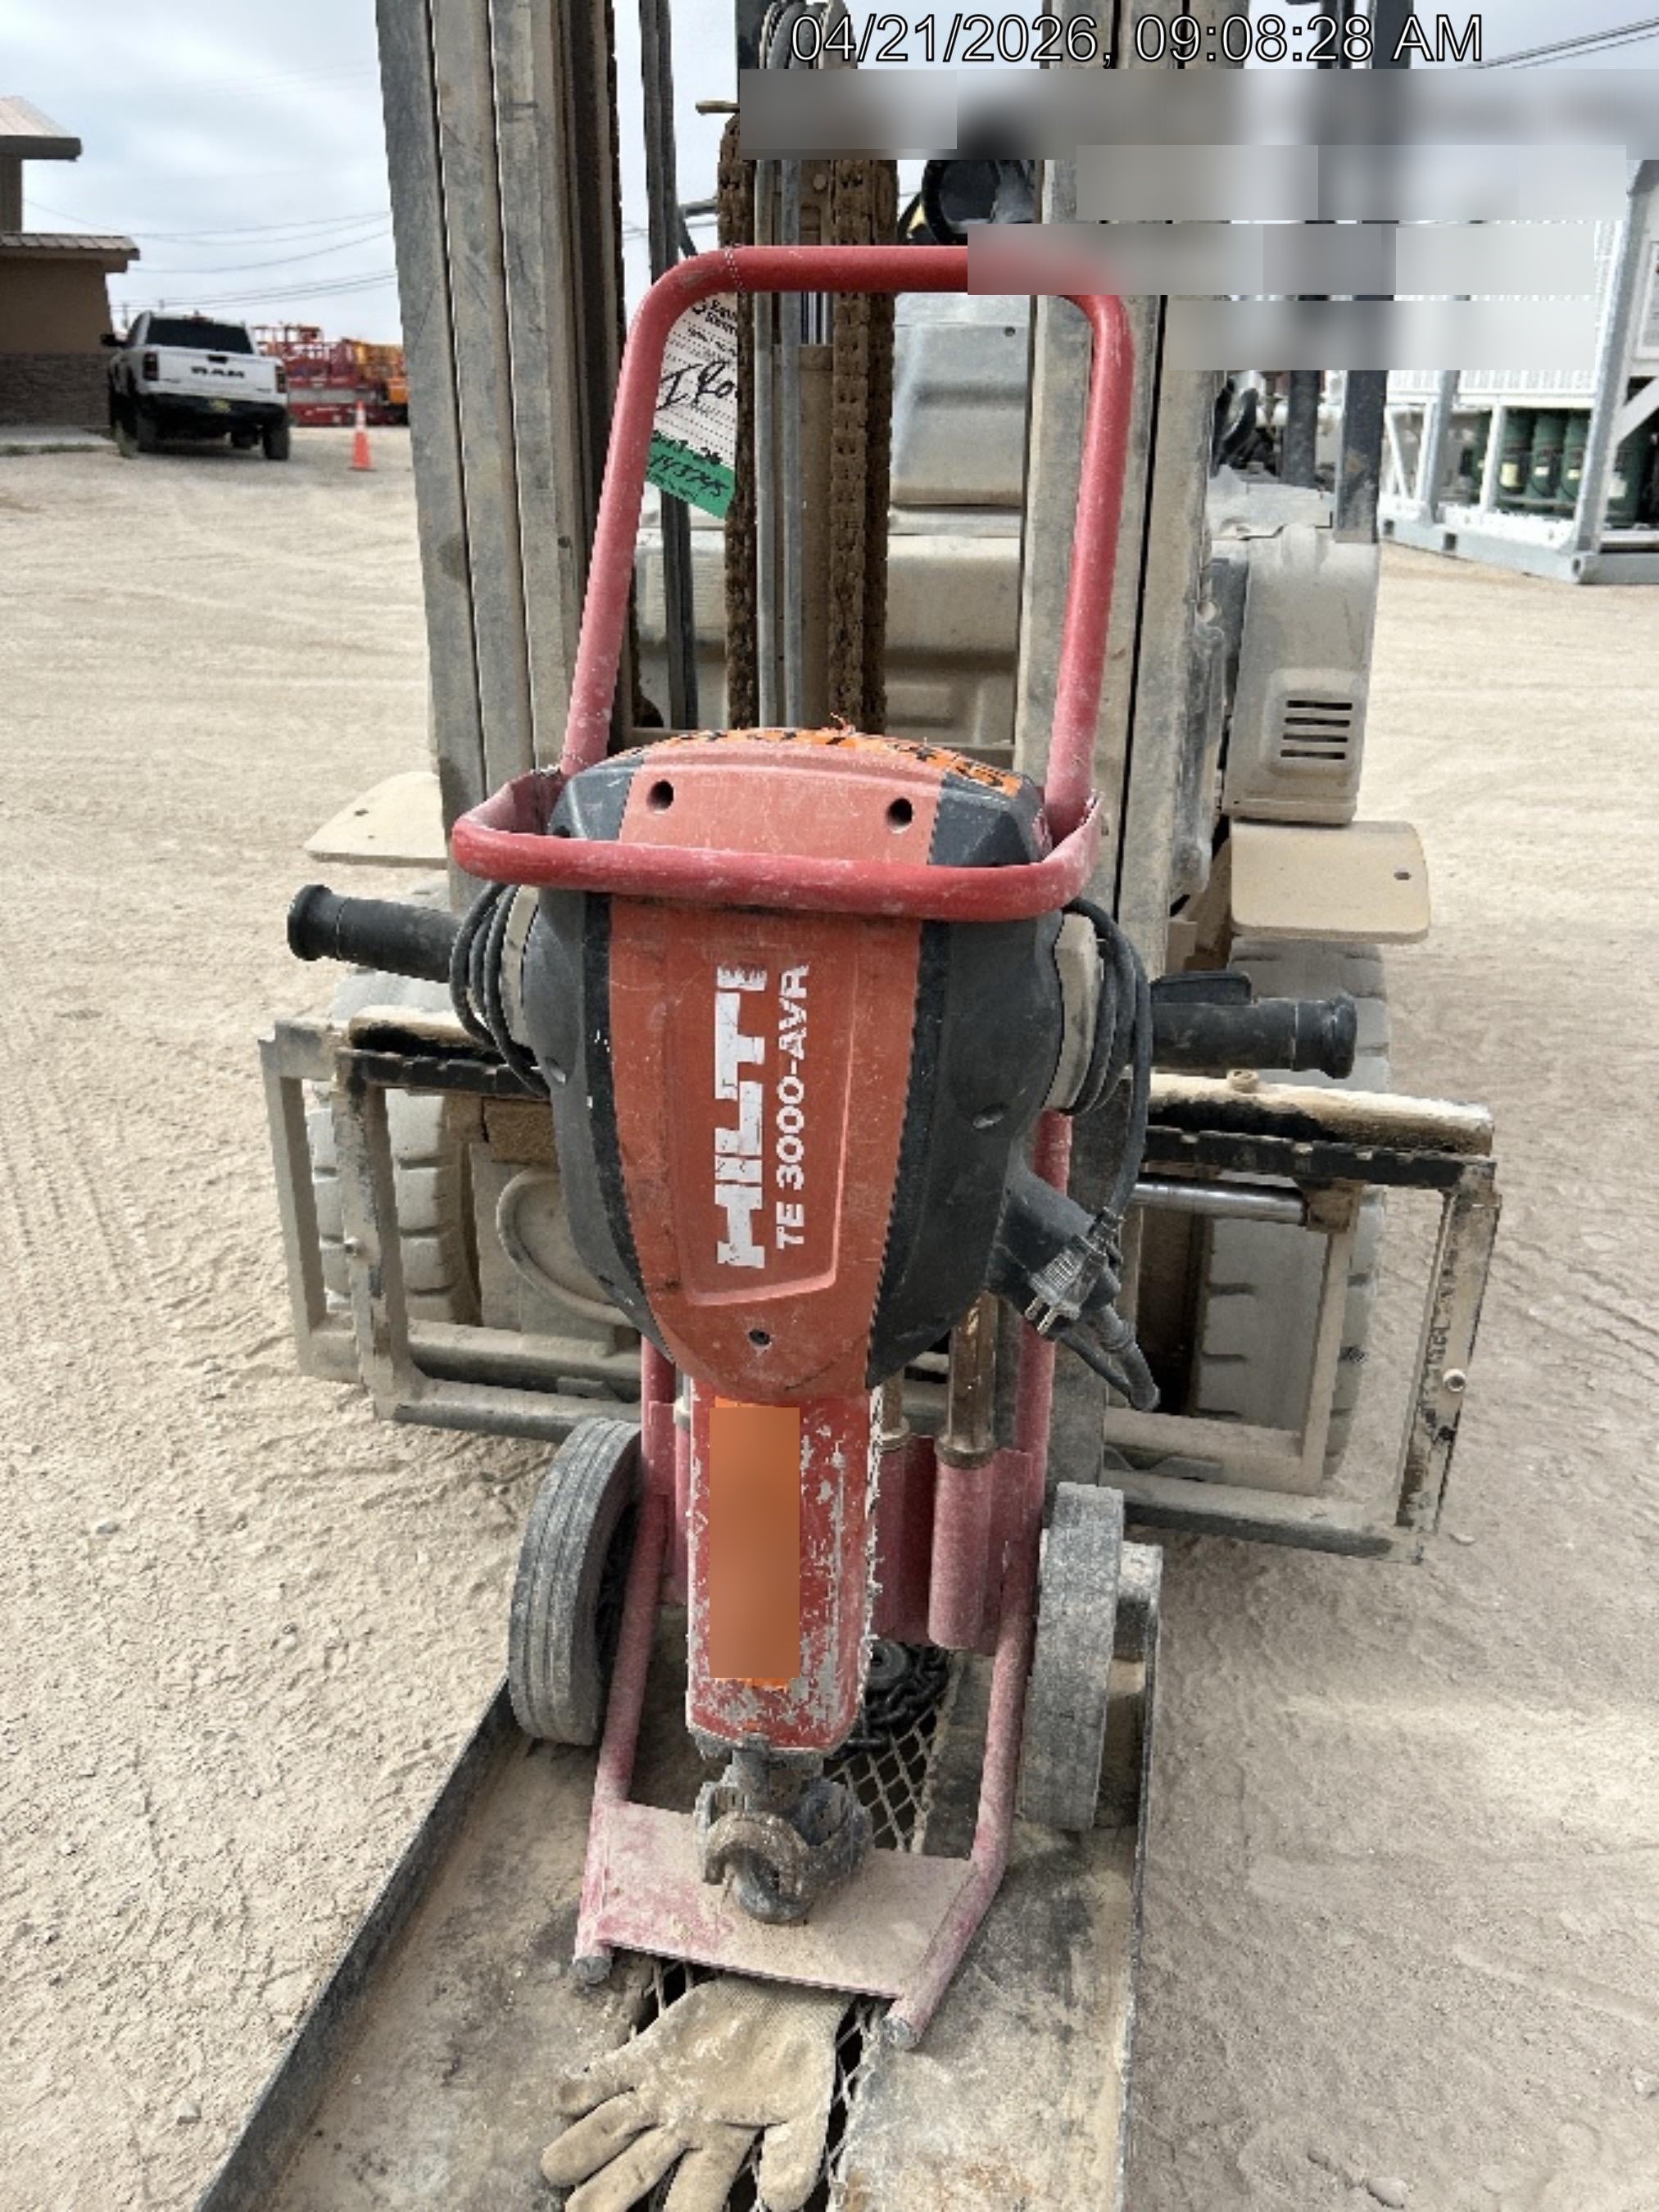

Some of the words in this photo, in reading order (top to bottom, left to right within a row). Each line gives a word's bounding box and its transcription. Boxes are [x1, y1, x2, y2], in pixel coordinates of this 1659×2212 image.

[714, 963, 768, 1270] HILTI
[775, 963, 810, 1192] 3000-AVR
[775, 1201, 805, 1250] TE
